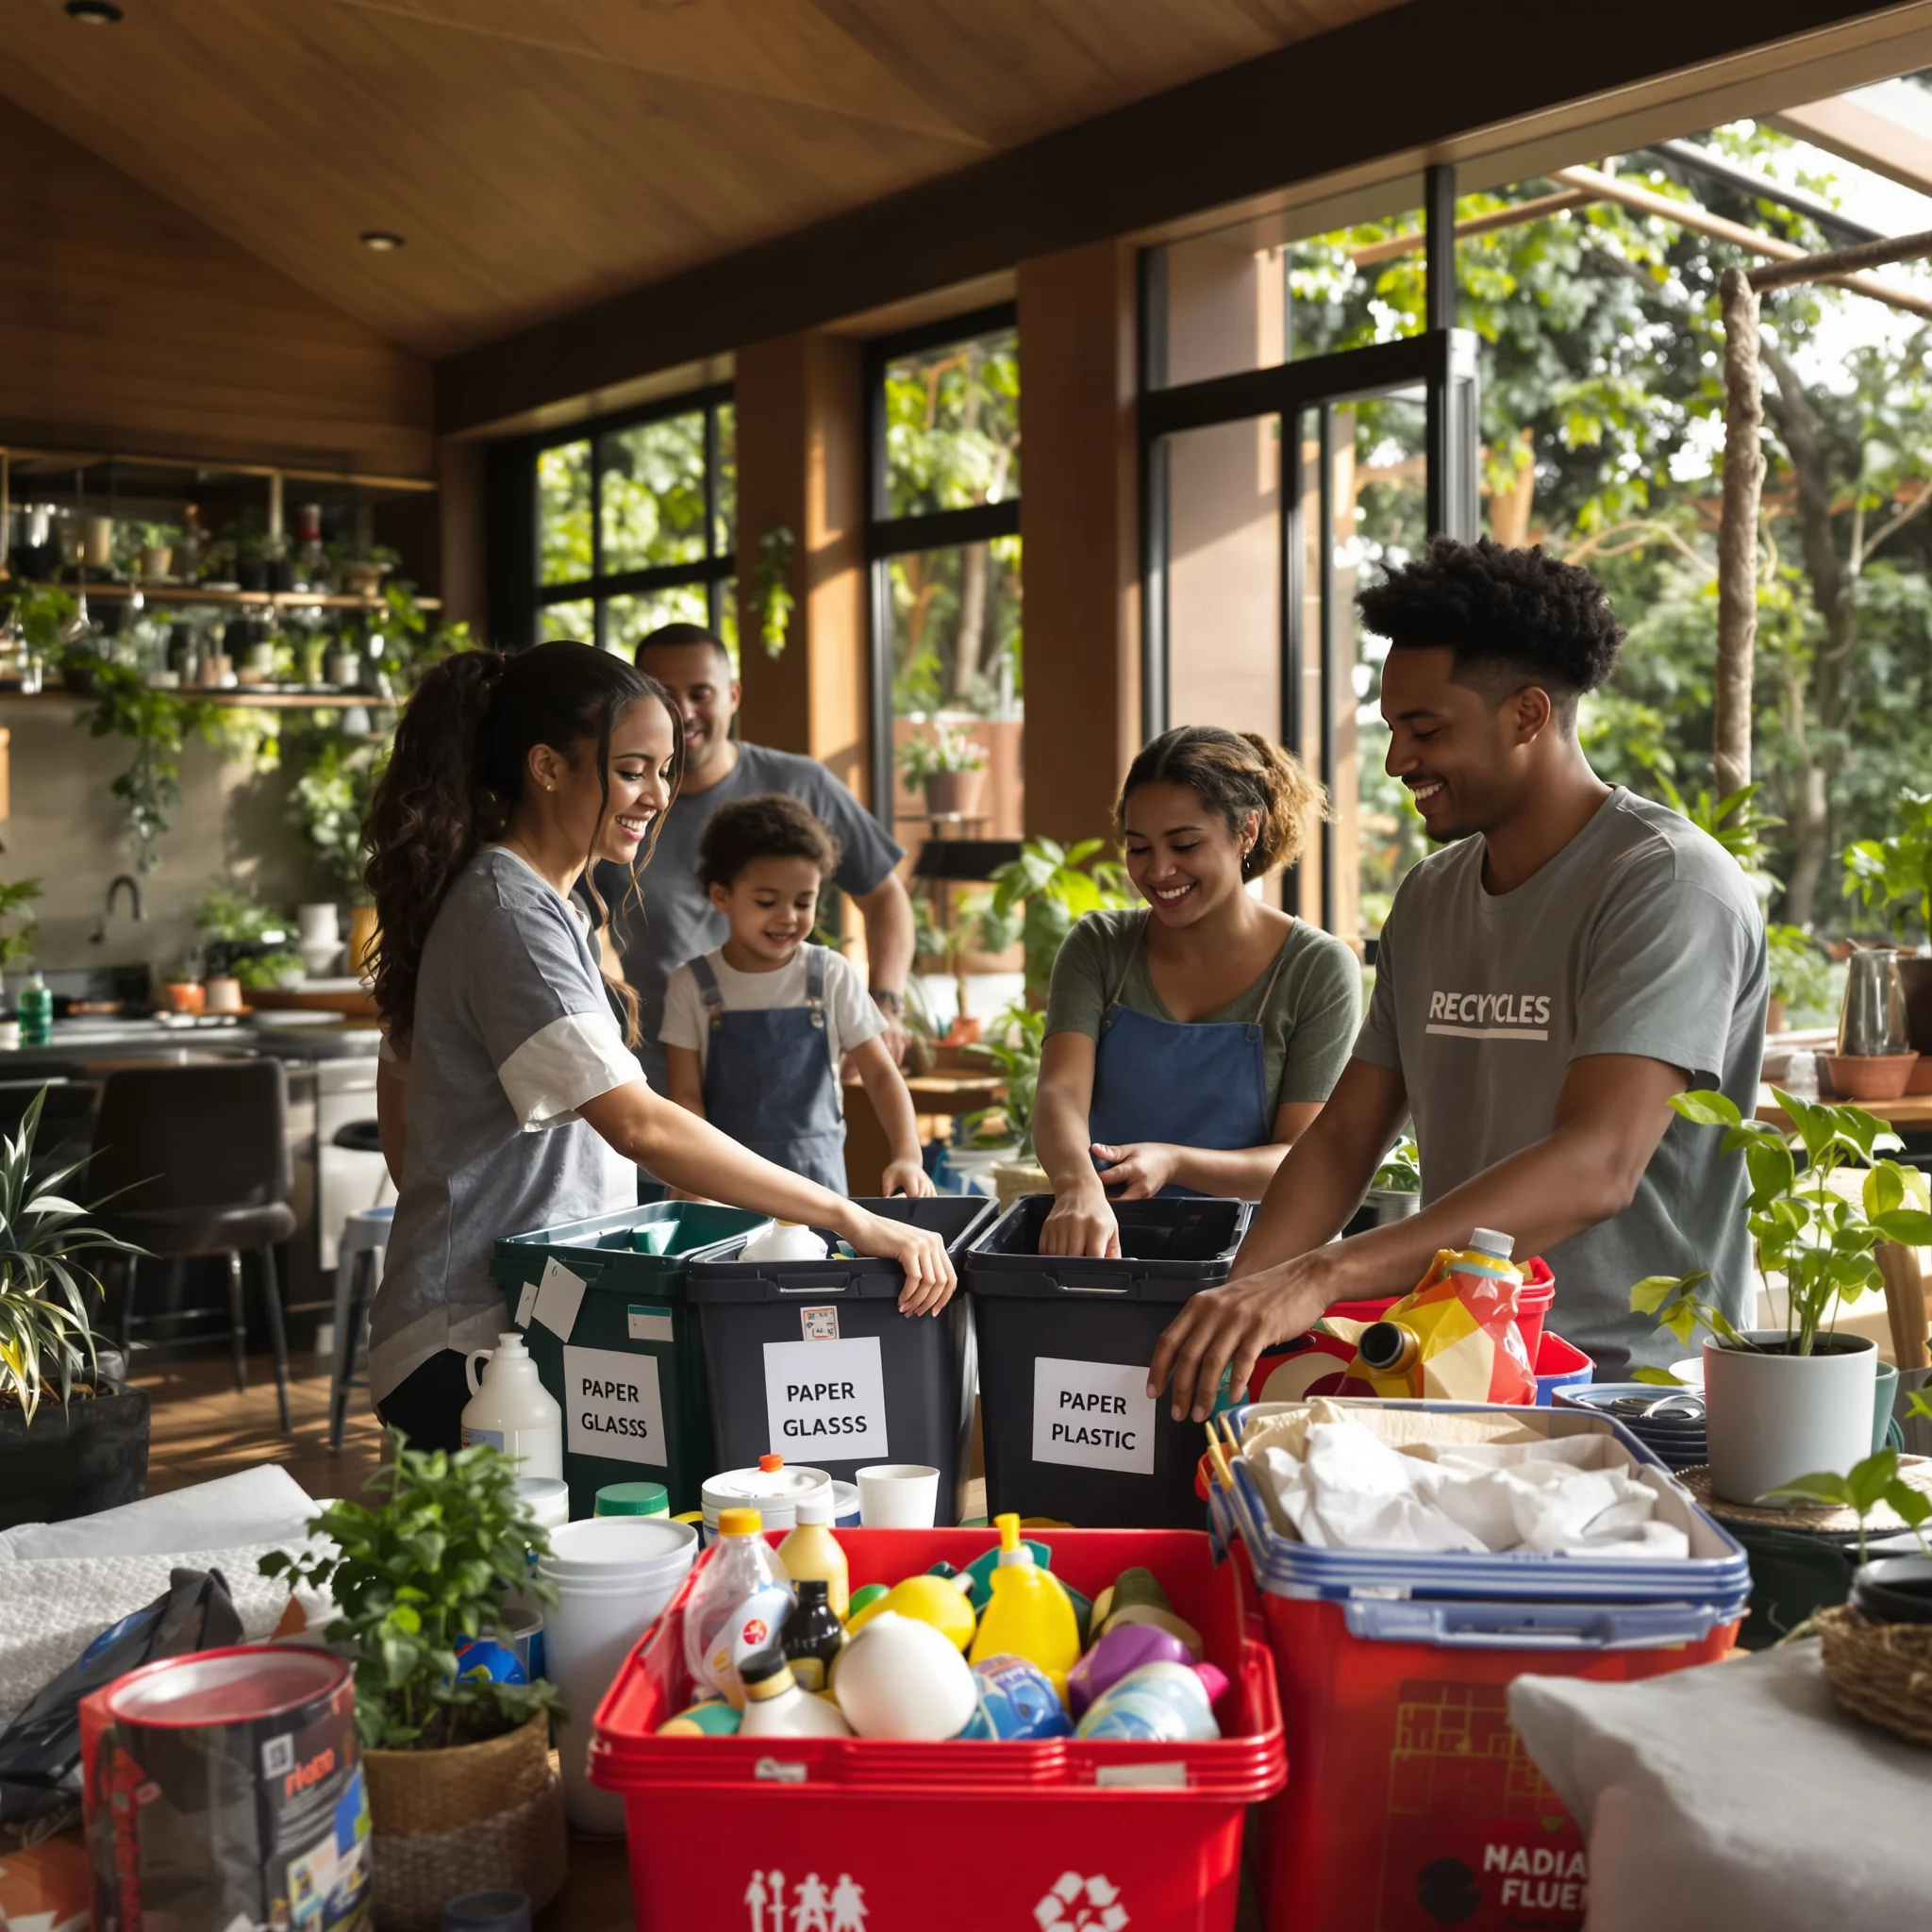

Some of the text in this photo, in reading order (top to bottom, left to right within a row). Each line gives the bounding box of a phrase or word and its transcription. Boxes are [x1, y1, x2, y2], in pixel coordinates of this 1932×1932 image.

[582, 1378, 640, 1403] PAPER
[787, 1382, 856, 1403] PAPER
[1059, 1391, 1126, 1415] PAPER
[581, 1412, 647, 1439] GLASSS
[783, 1415, 868, 1437] GLASSS
[1052, 1423, 1136, 1450] PLASTIC
